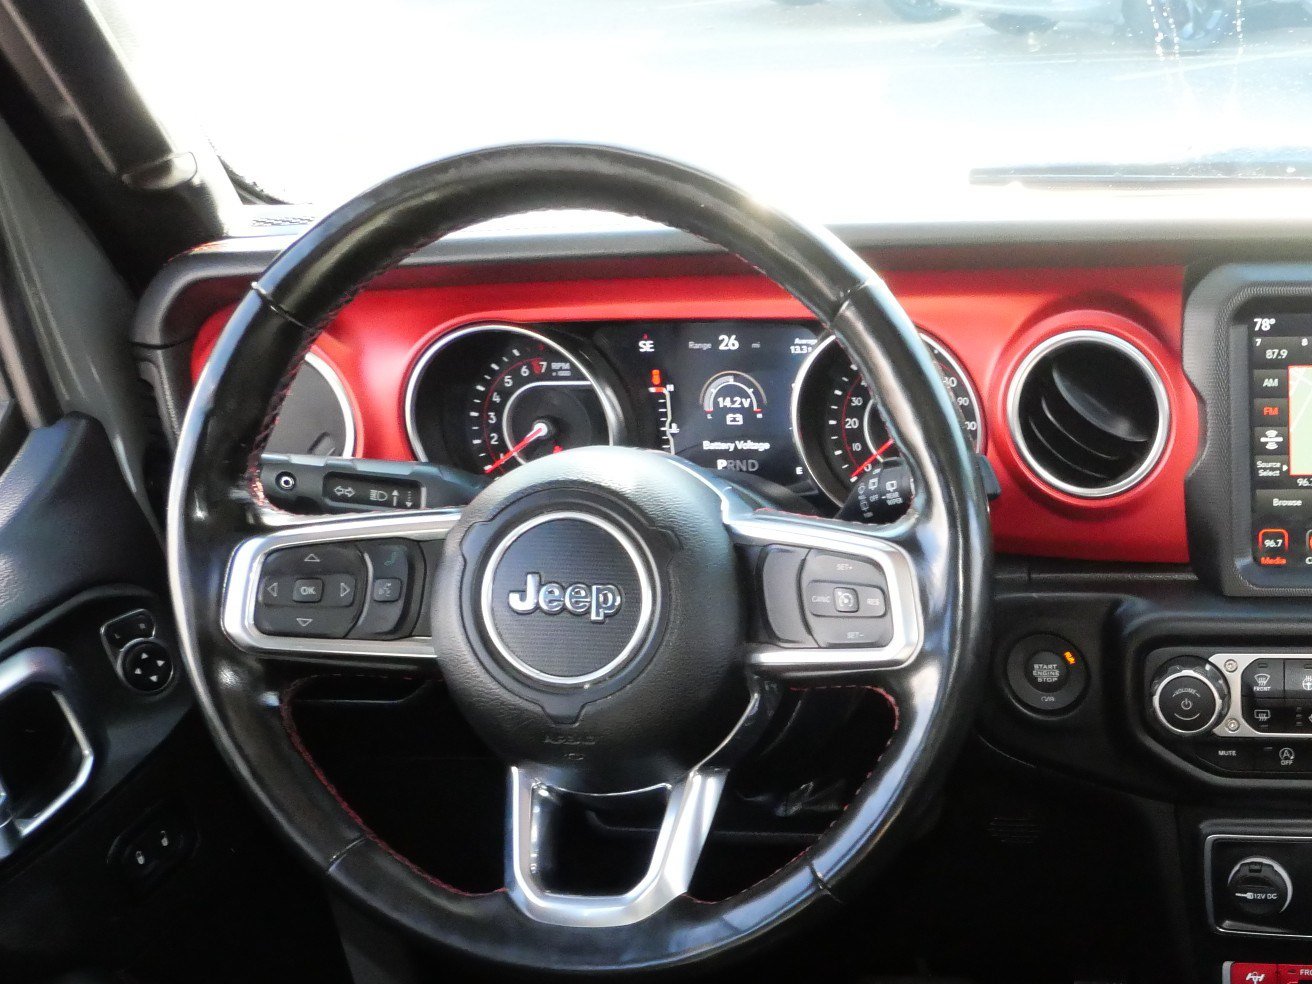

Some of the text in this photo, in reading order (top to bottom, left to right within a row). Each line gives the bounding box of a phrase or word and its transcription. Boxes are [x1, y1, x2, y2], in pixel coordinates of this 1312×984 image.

[1253, 318, 1276, 331] 78°
[638, 340, 655, 352] SE
[688, 341, 712, 350] Range
[718, 334, 740, 350] 26
[1255, 338, 1262, 346] 7
[1265, 349, 1288, 359] 87.9
[520, 365, 530, 377] 6
[539, 361, 547, 373] 7
[551, 362, 571, 370] RPM
[504, 375, 513, 387] 5
[1262, 378, 1279, 387] AM
[492, 392, 501, 404] 4
[850, 397, 863, 406] 30
[1263, 406, 1279, 416] FM
[488, 411, 497, 424] 3
[845, 418, 859, 429] 20
[490, 433, 499, 445] 2
[702, 440, 771, 452] Battery Voltage
[852, 443, 862, 452] 10
[1256, 460, 1281, 469] Source
[795, 466, 803, 475] E
[1258, 469, 1281, 477] Select
[1272, 498, 1302, 507] Browse
[1263, 538, 1283, 548] 96.7
[1260, 556, 1287, 565] Media
[300, 586, 317, 595] OK
[508, 572, 622, 622] Jeep
